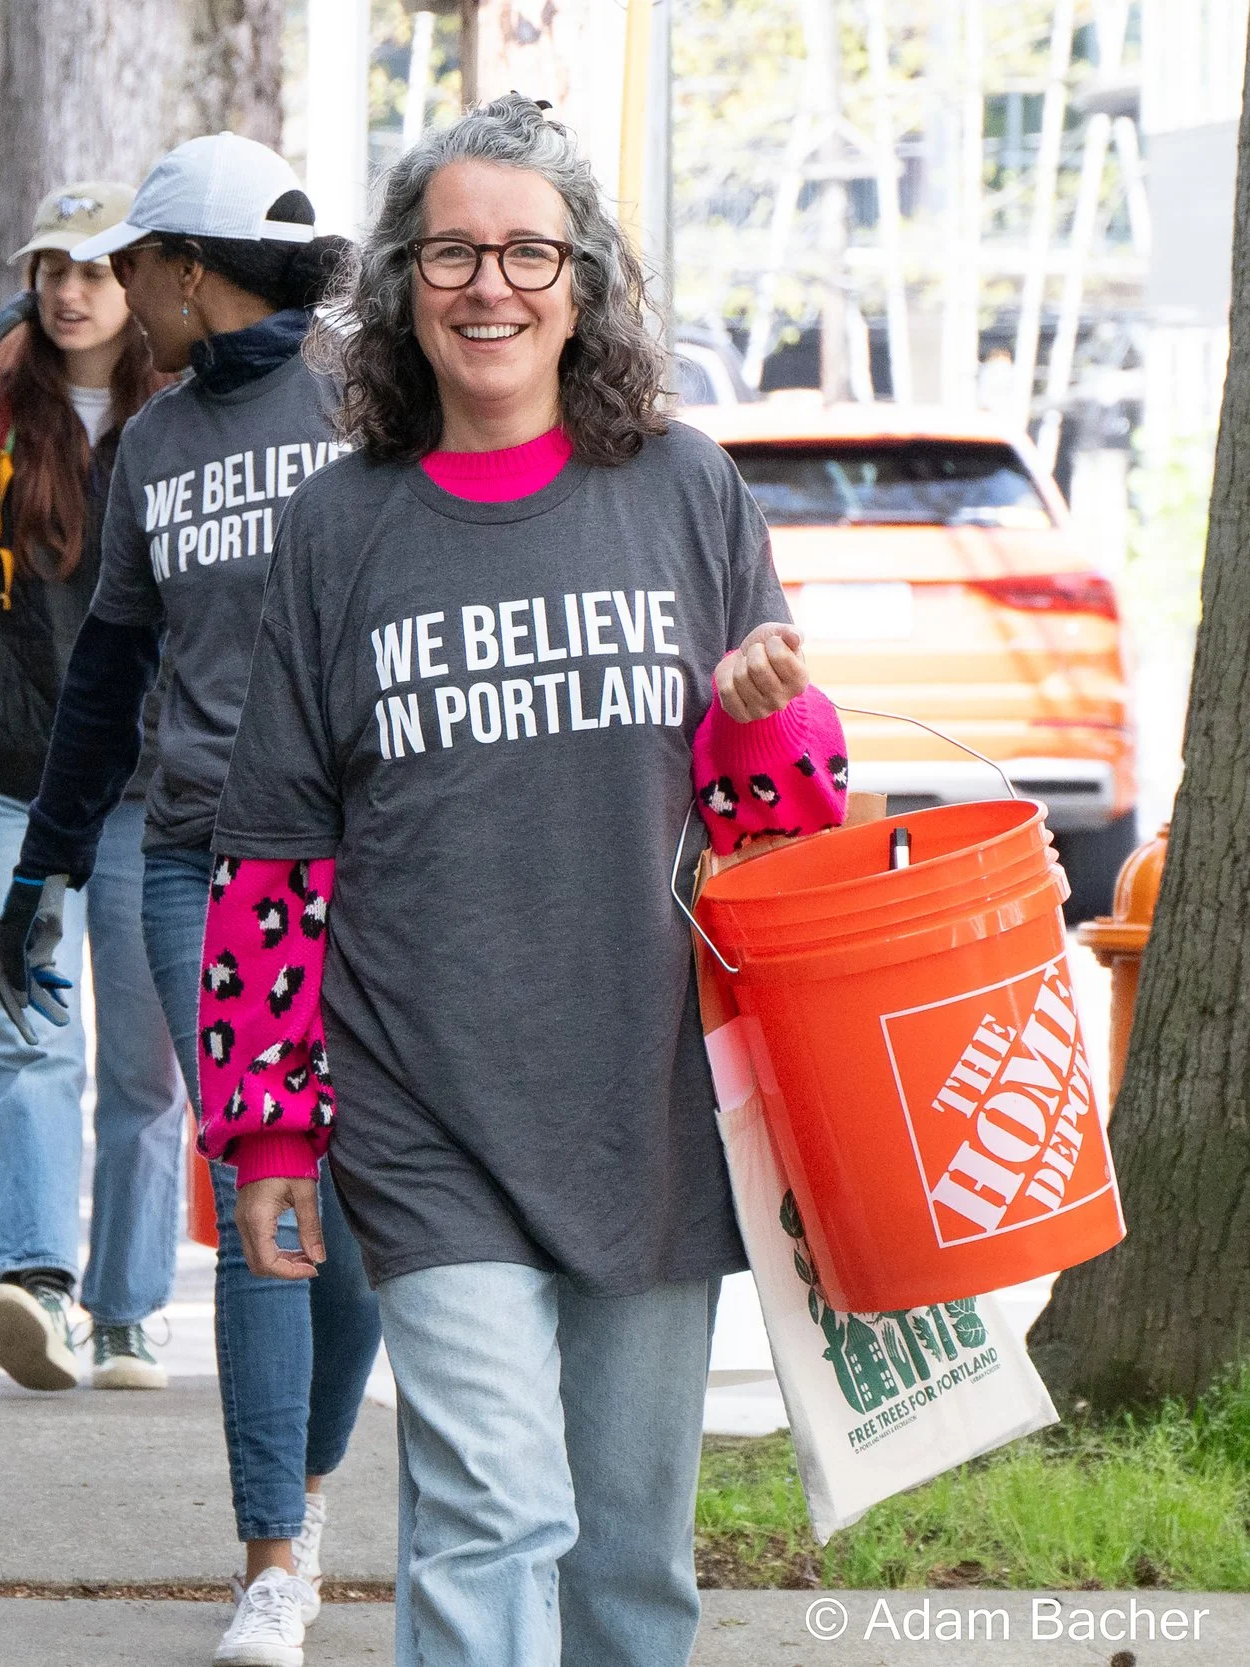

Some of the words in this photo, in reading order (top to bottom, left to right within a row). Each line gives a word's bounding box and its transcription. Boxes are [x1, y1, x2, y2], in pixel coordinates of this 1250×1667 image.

[144, 469, 196, 533] WE
[370, 611, 449, 691] WE
[461, 590, 680, 672] BELIEVE
[375, 693, 426, 760] IN
[435, 665, 684, 749] PORTLAND
[931, 1012, 1018, 1119] THE
[931, 962, 1077, 1233] HOME
[847, 1419, 878, 1448] FREE
[875, 1400, 910, 1430] TREES
[908, 1385, 938, 1412] FOR
